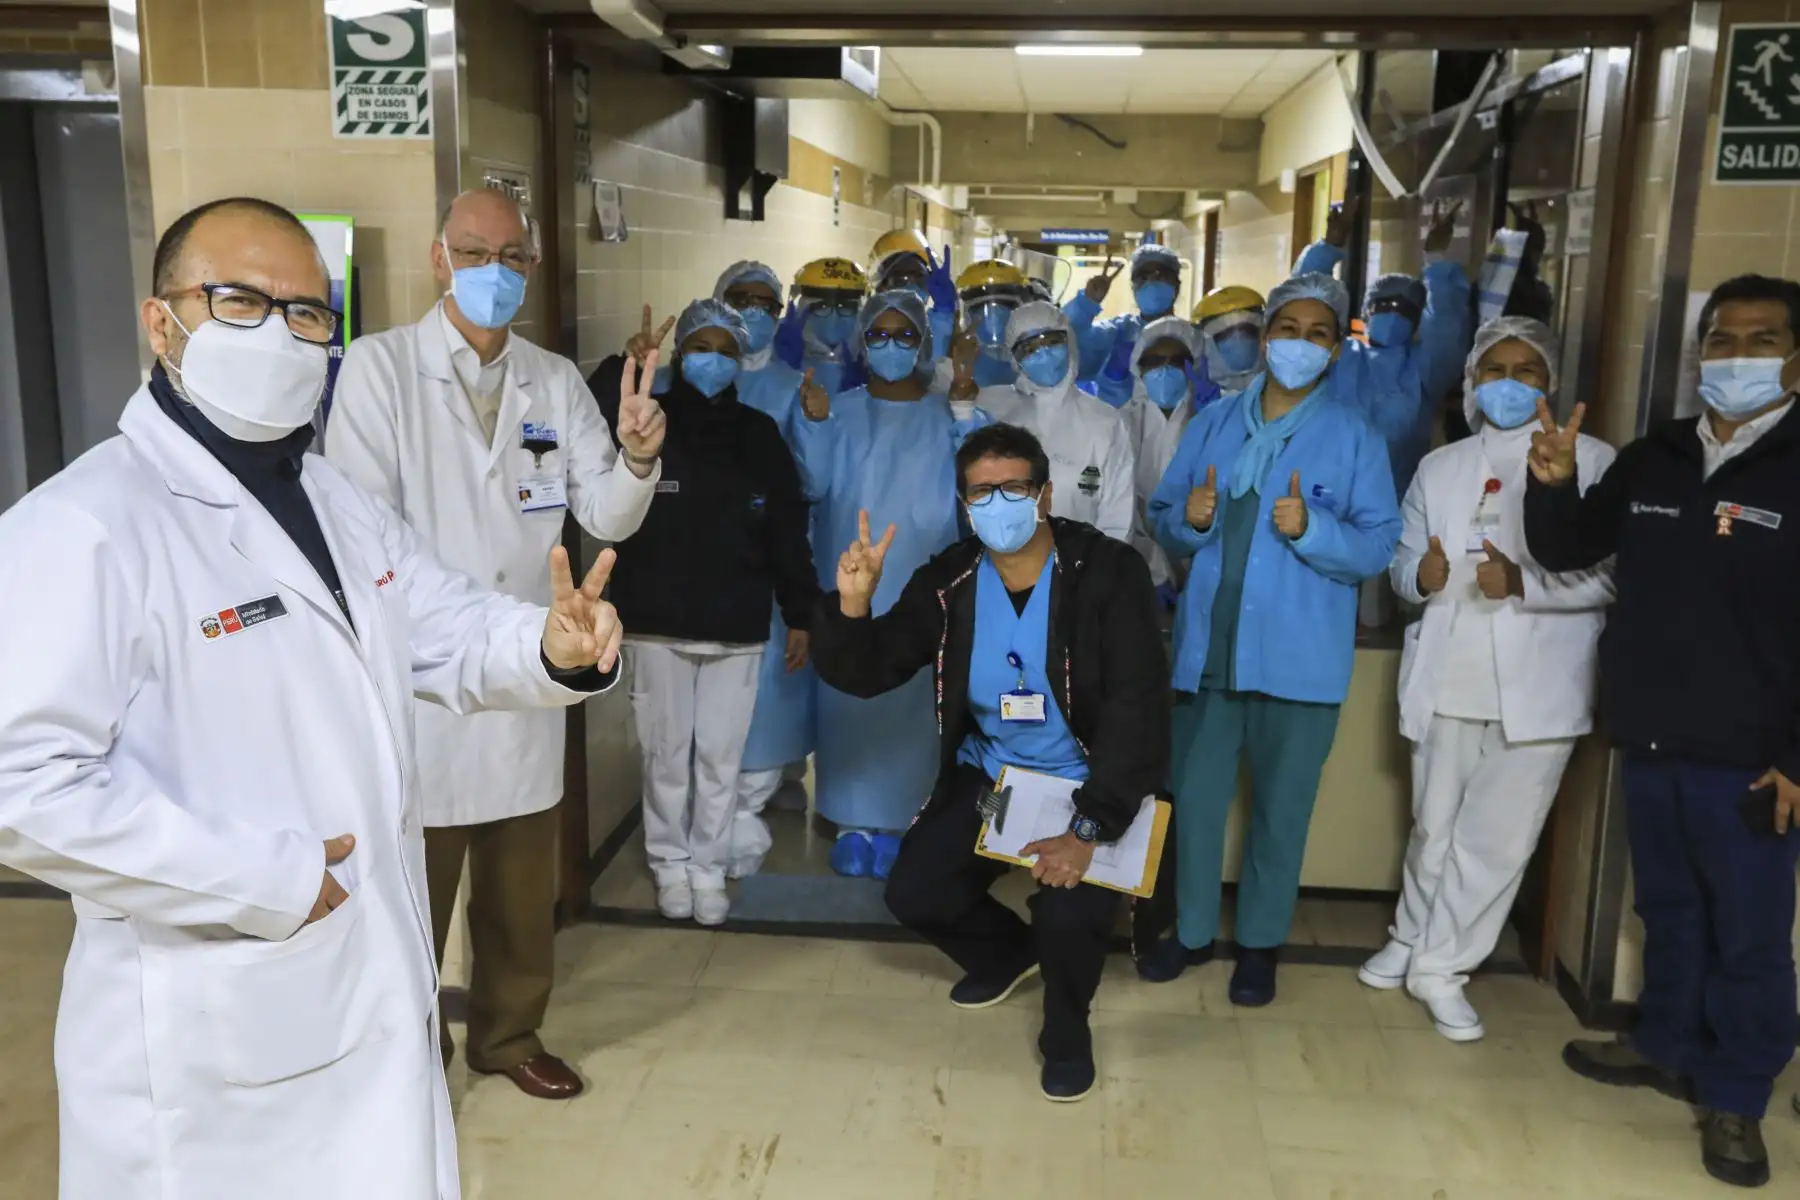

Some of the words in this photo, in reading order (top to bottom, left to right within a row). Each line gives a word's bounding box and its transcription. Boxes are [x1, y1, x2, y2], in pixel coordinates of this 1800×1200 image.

[348, 86, 374, 96] ZONA
[377, 86, 416, 96] SEGURA
[358, 98, 371, 108] EN
[374, 98, 407, 108] CASOS
[356, 110, 369, 120] DE
[371, 110, 409, 120] SISMOS
[1722, 144, 1800, 169] SALID
[222, 616, 239, 627] PERÚ
